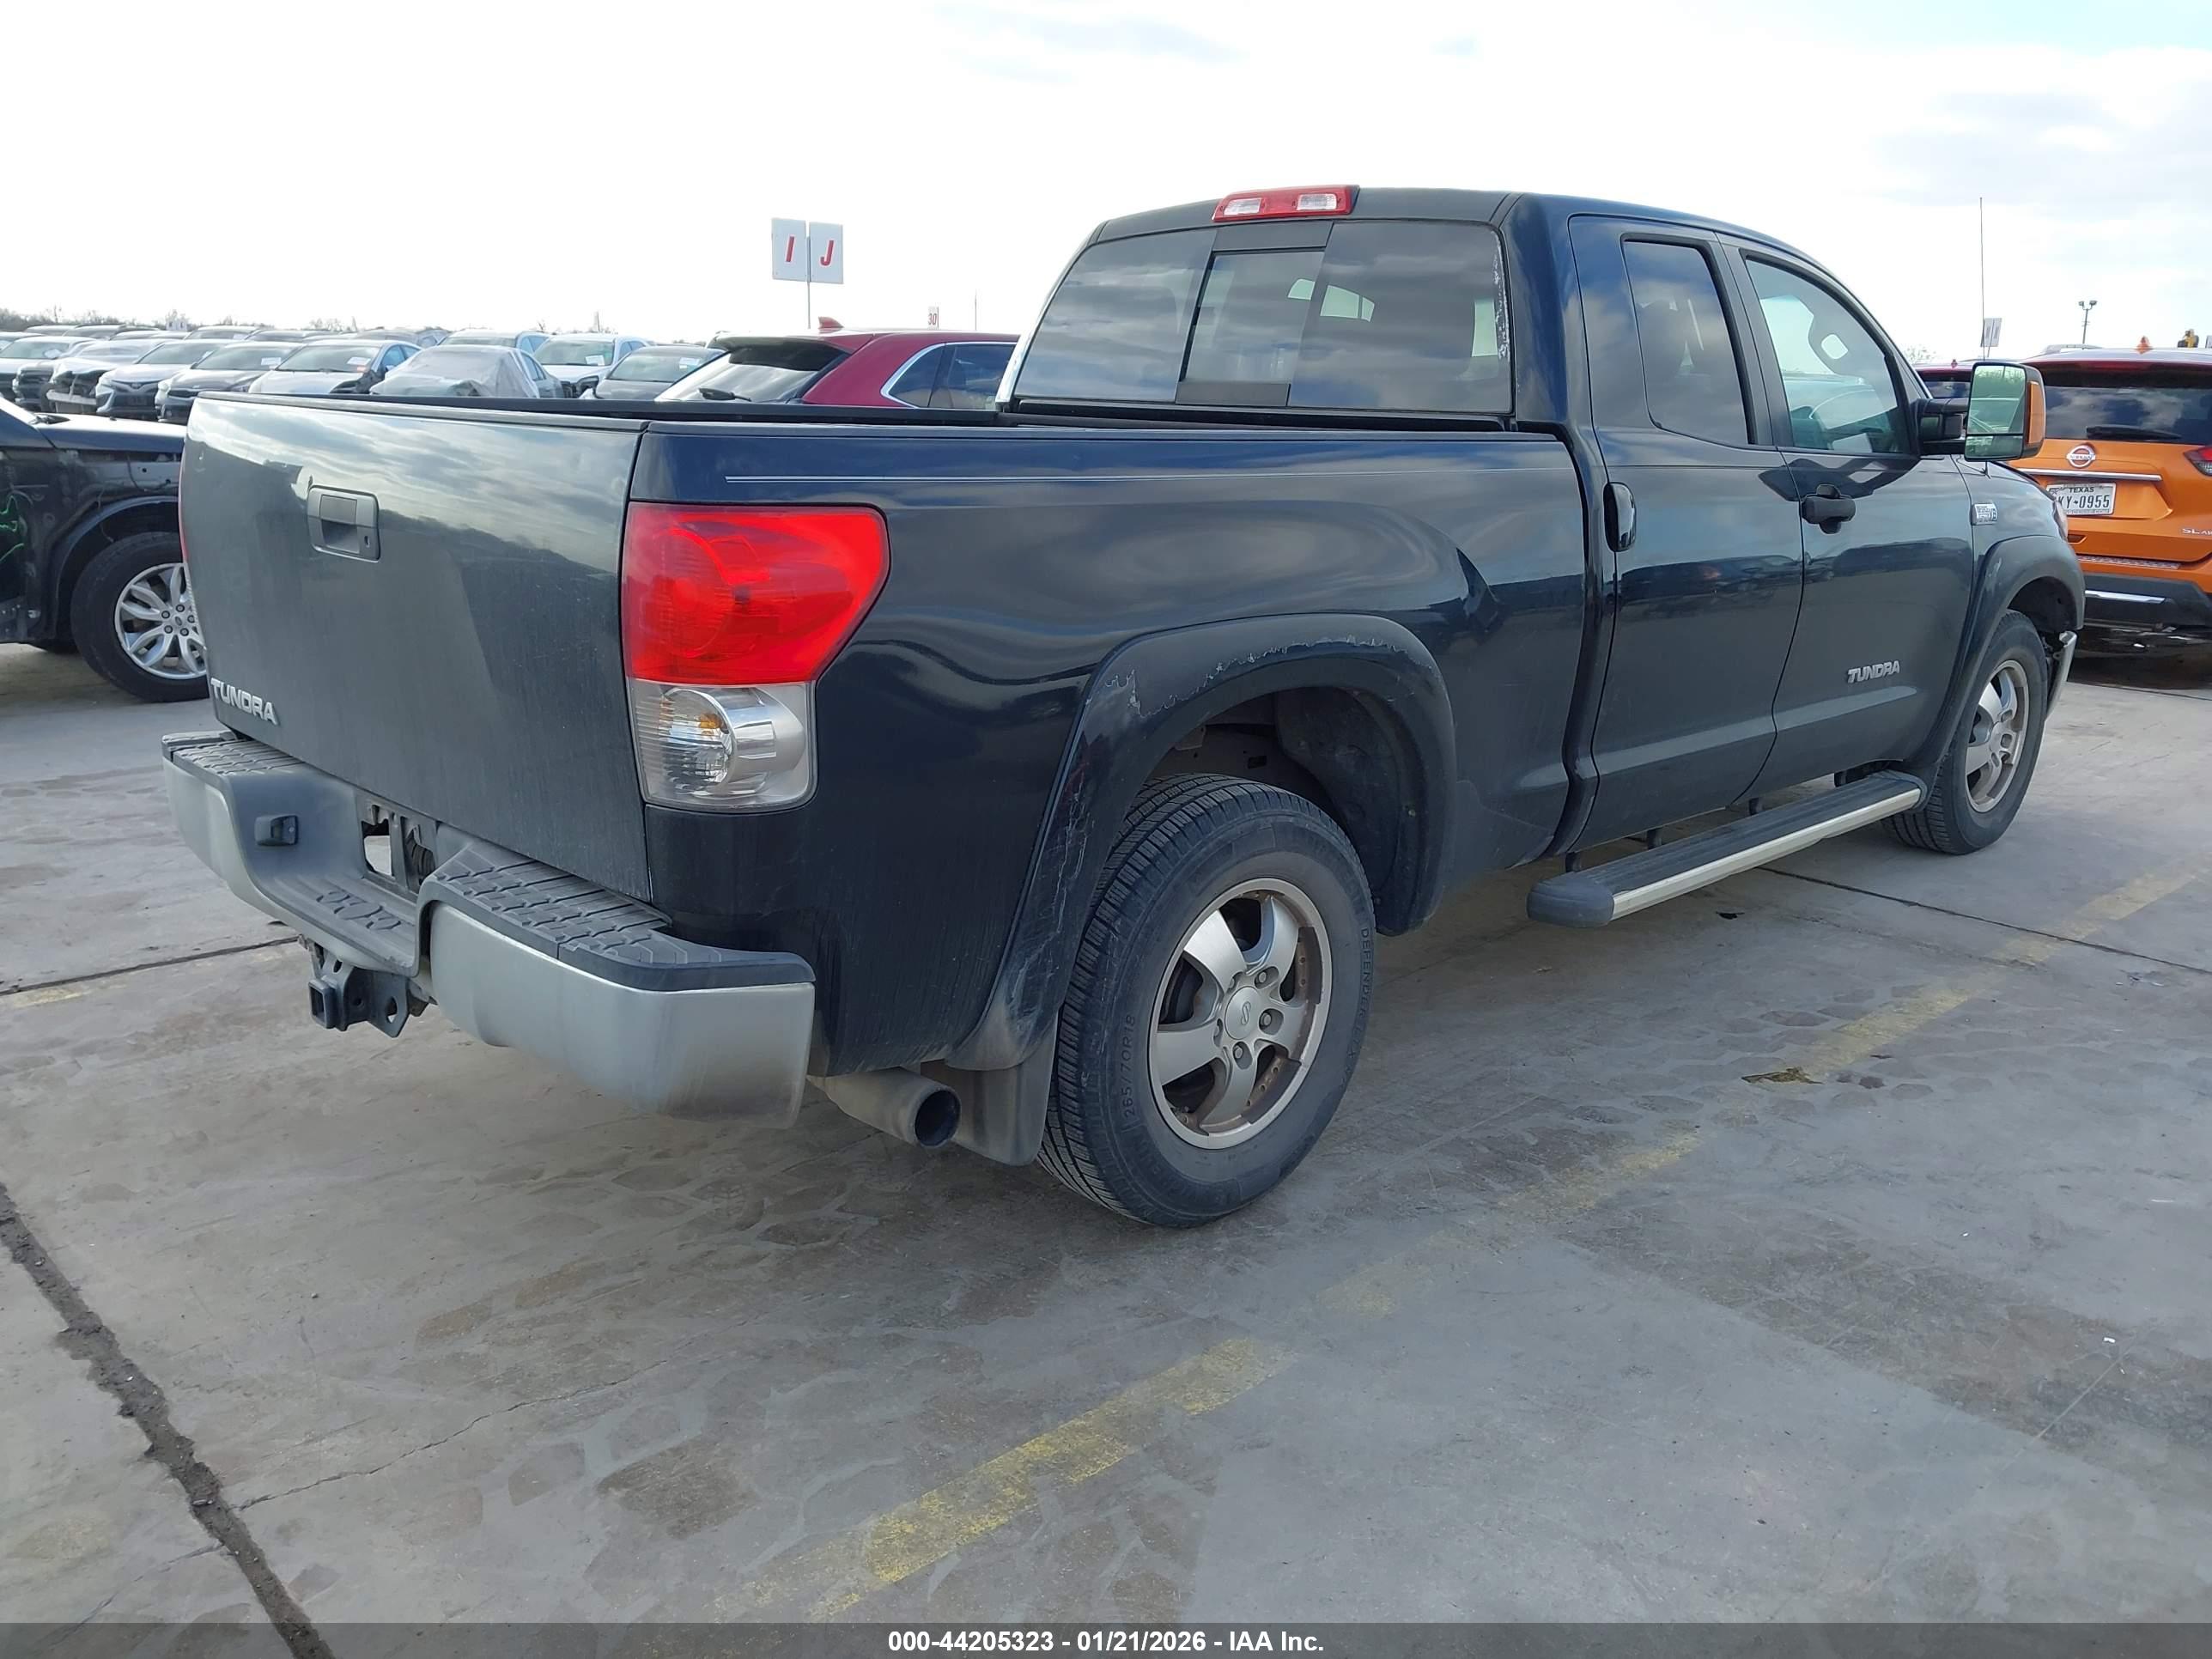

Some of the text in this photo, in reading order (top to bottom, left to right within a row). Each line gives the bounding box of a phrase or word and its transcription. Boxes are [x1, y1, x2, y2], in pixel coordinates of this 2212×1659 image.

[786, 236, 794, 262] I
[820, 240, 834, 266] J
[1847, 660, 1900, 684] TUNDRA
[210, 677, 277, 726] TUNDRA
